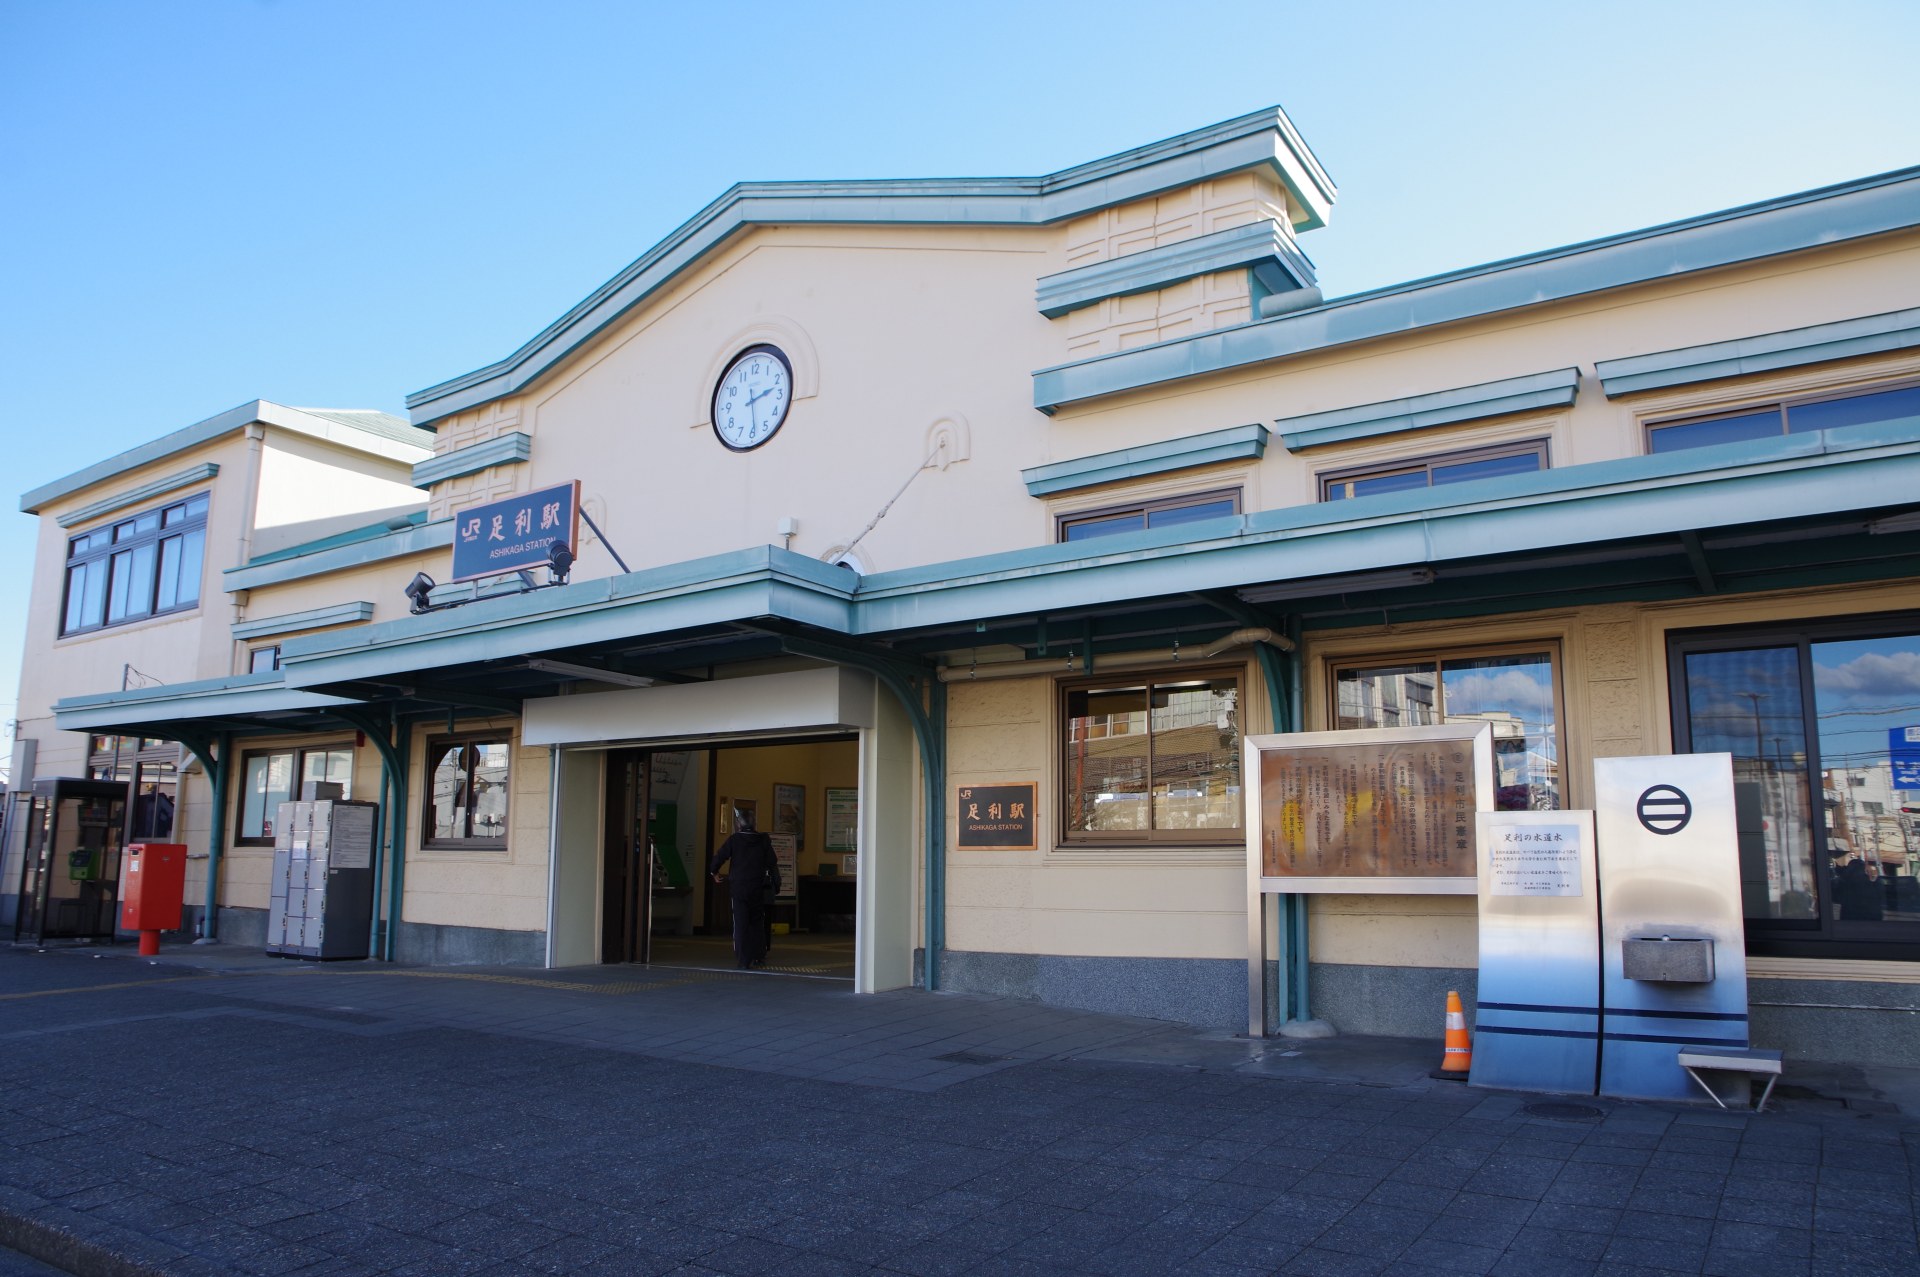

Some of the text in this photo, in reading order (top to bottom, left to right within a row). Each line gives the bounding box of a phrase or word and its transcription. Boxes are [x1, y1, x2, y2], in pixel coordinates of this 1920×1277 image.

[751, 363, 760, 376] 12
[739, 371, 747, 383] 11
[774, 374, 781, 385] 2
[729, 386, 737, 398] 10
[776, 389, 783, 400] 3
[725, 402, 732, 414] 9
[772, 405, 778, 417] 4
[728, 417, 735, 429] 8
[762, 420, 769, 432] 5
[737, 426, 744, 438] 7
[749, 426, 756, 439] 6
[462, 502, 561, 542] JR 足利駅
[489, 544, 524, 559] ASHIKAGA
[961, 790, 972, 798] JR
[967, 802, 1025, 821] 足利駅
[1455, 771, 1467, 850] 足利市民憲章
[998, 823, 1023, 831] STATION
[1504, 833, 1563, 842] 足利の水道水
